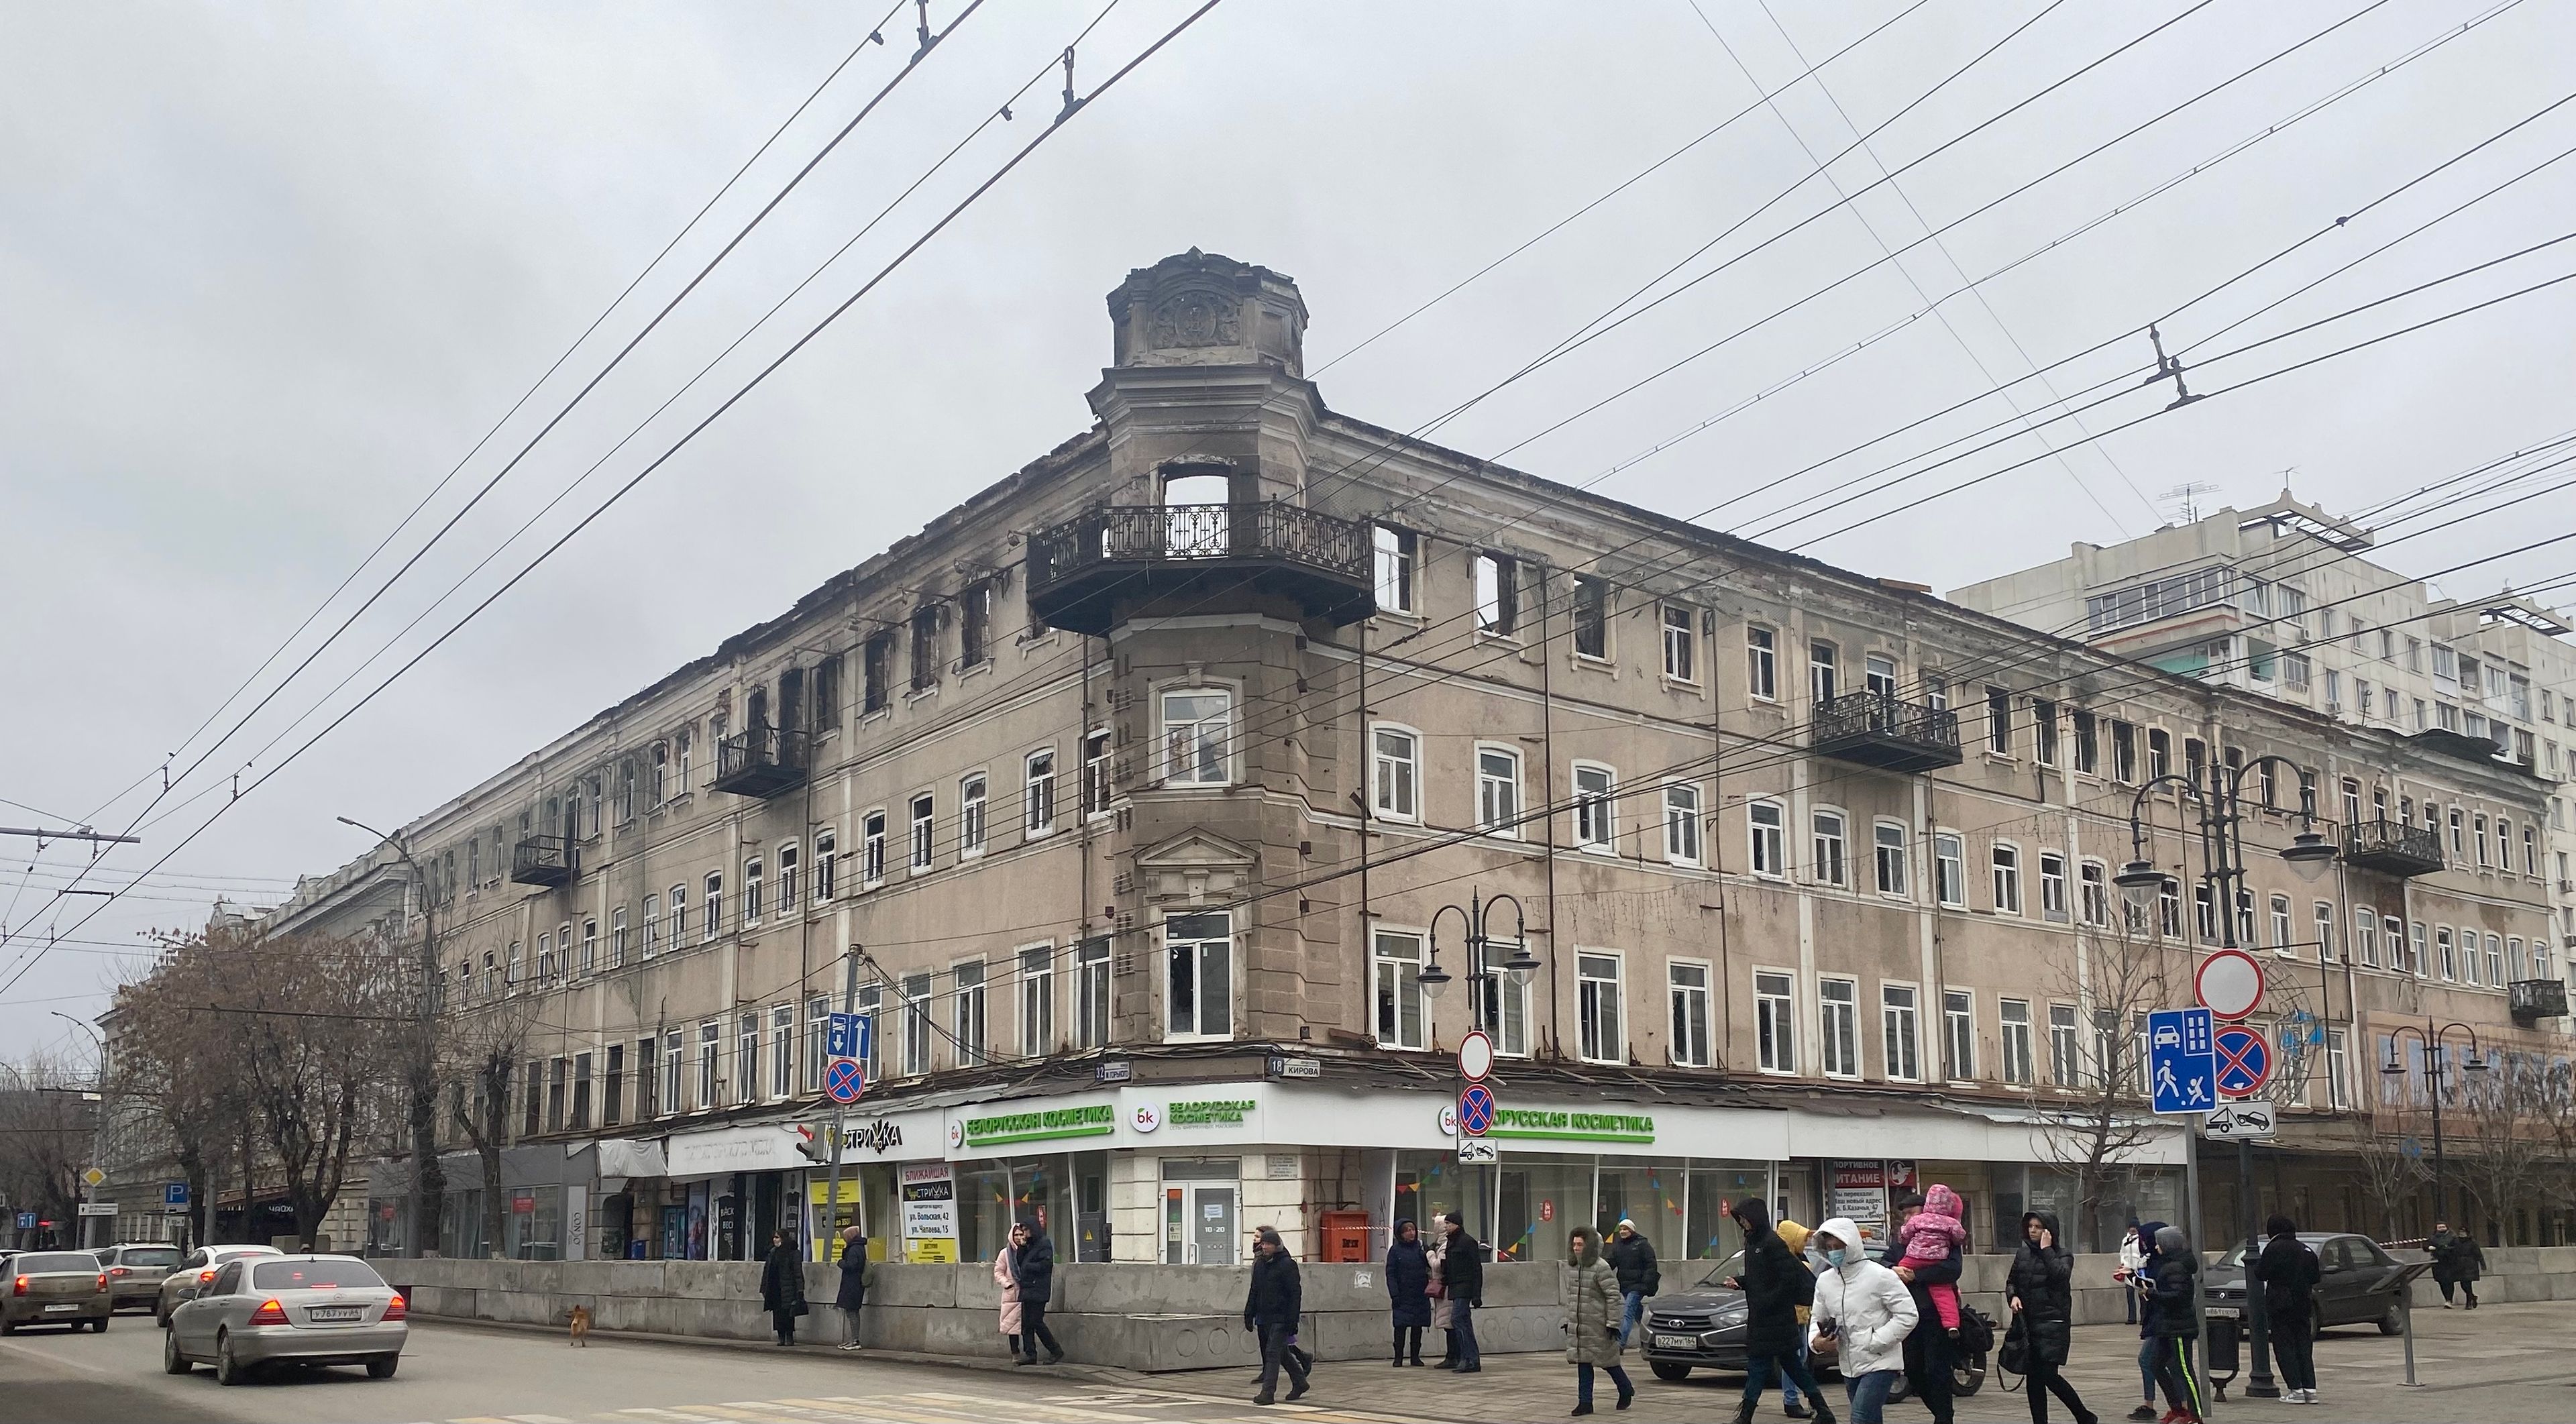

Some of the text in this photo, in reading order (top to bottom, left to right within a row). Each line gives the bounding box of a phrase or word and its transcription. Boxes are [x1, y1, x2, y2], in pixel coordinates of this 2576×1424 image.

[1096, 1066, 1104, 1078] 32
[1273, 1060, 1318, 1076] 18 КИРОВА
[1169, 1100, 1256, 1112] БЕЛОРУССКАЯ
[967, 1105, 1115, 1134] БЕЛОРУССКАЯ КОСМЕТИКА
[1169, 1111, 1244, 1124] КОСМЕТИКА
[1495, 1109, 1654, 1132] ОРУССКАЯ КОСМЕТИКА
[1833, 1161, 1879, 1169] ПОРТИВНОЕ
[906, 1167, 949, 1181] БЛИЖАЙШАЯ
[1835, 1173, 1880, 1184] ИТАНИЕ
[917, 1212, 942, 1221] Вольская,
[943, 1212, 949, 1220] 42
[911, 1225, 949, 1235] ул. Чапаева, 15
